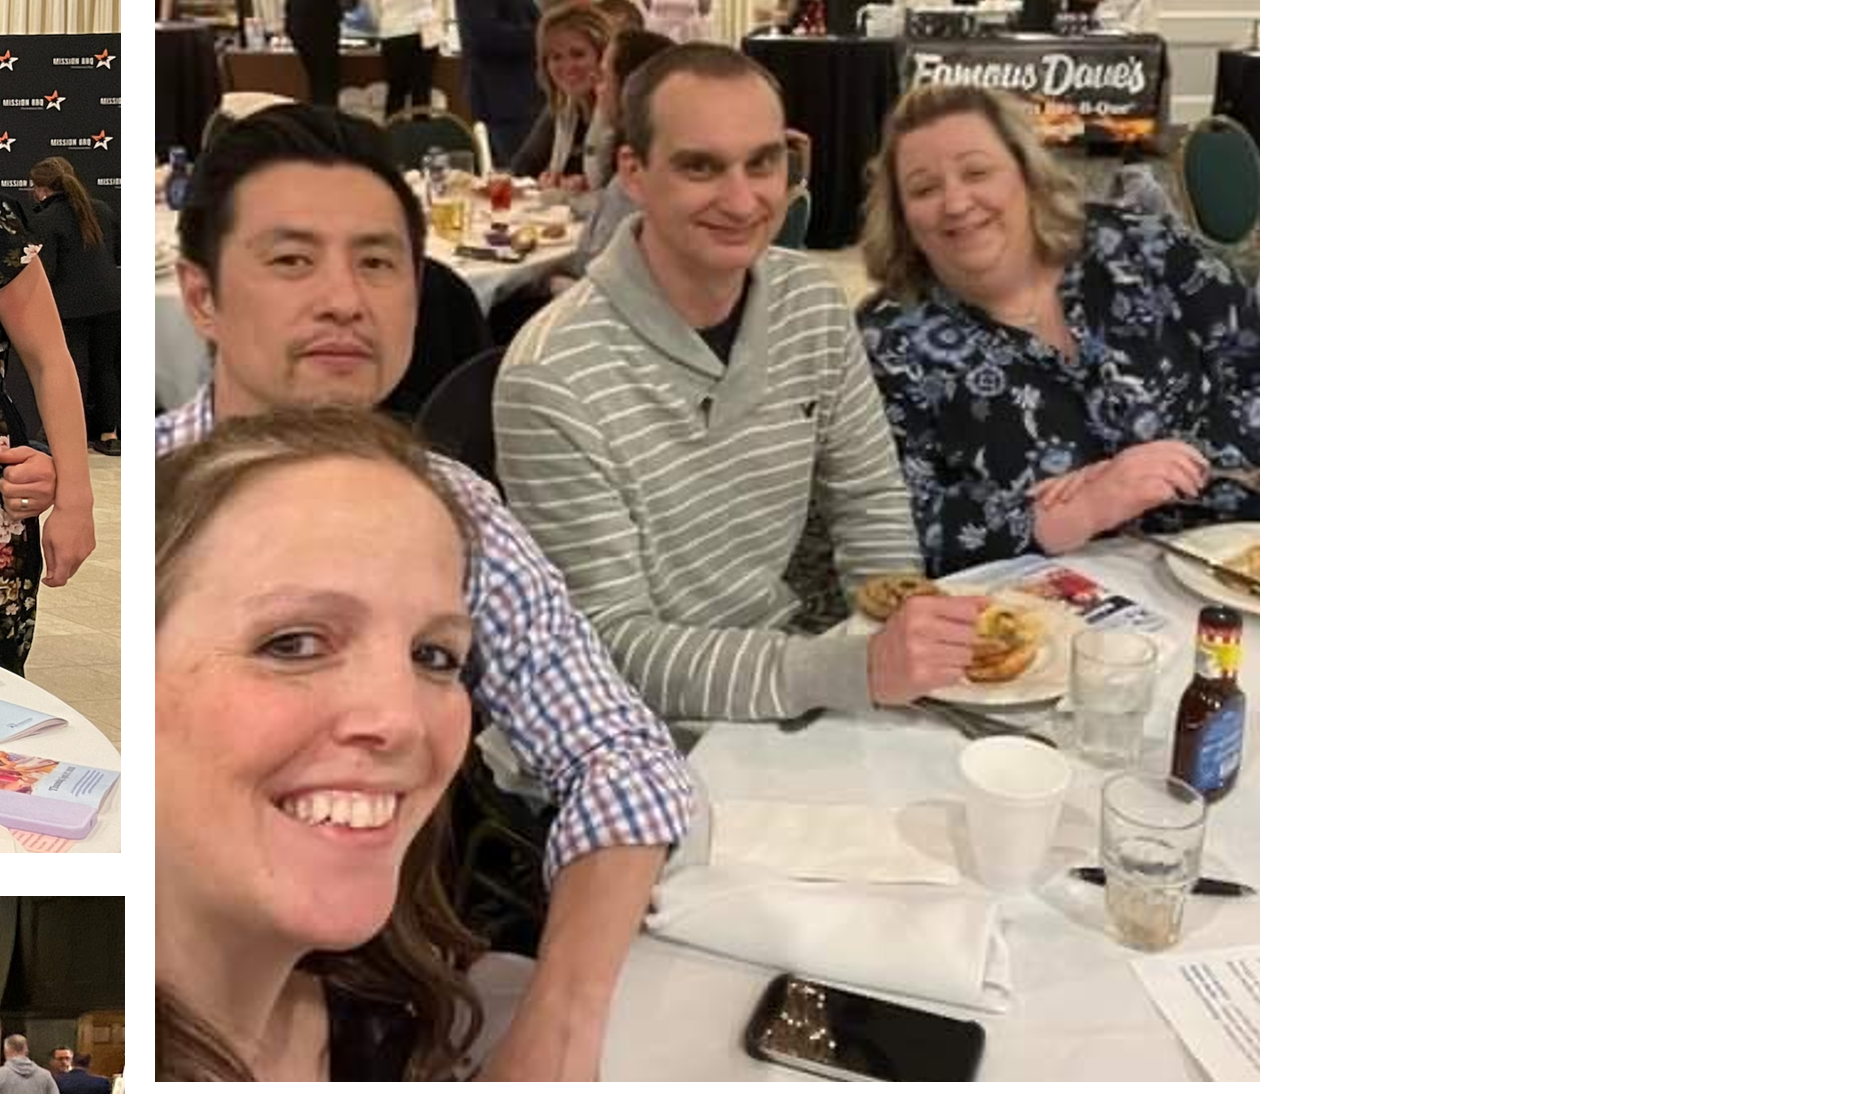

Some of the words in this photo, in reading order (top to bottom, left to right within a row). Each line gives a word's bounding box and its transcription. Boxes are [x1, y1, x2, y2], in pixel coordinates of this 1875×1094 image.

[52, 57, 80, 66] MISSION
[81, 57, 94, 66] BBQ
[911, 53, 1038, 90] Famous
[1041, 53, 1146, 96] Dave's
[2, 98, 30, 107] MISSION
[31, 98, 44, 107] BBQ
[50, 138, 78, 147] MISSION
[1, 179, 28, 188] MISSION
